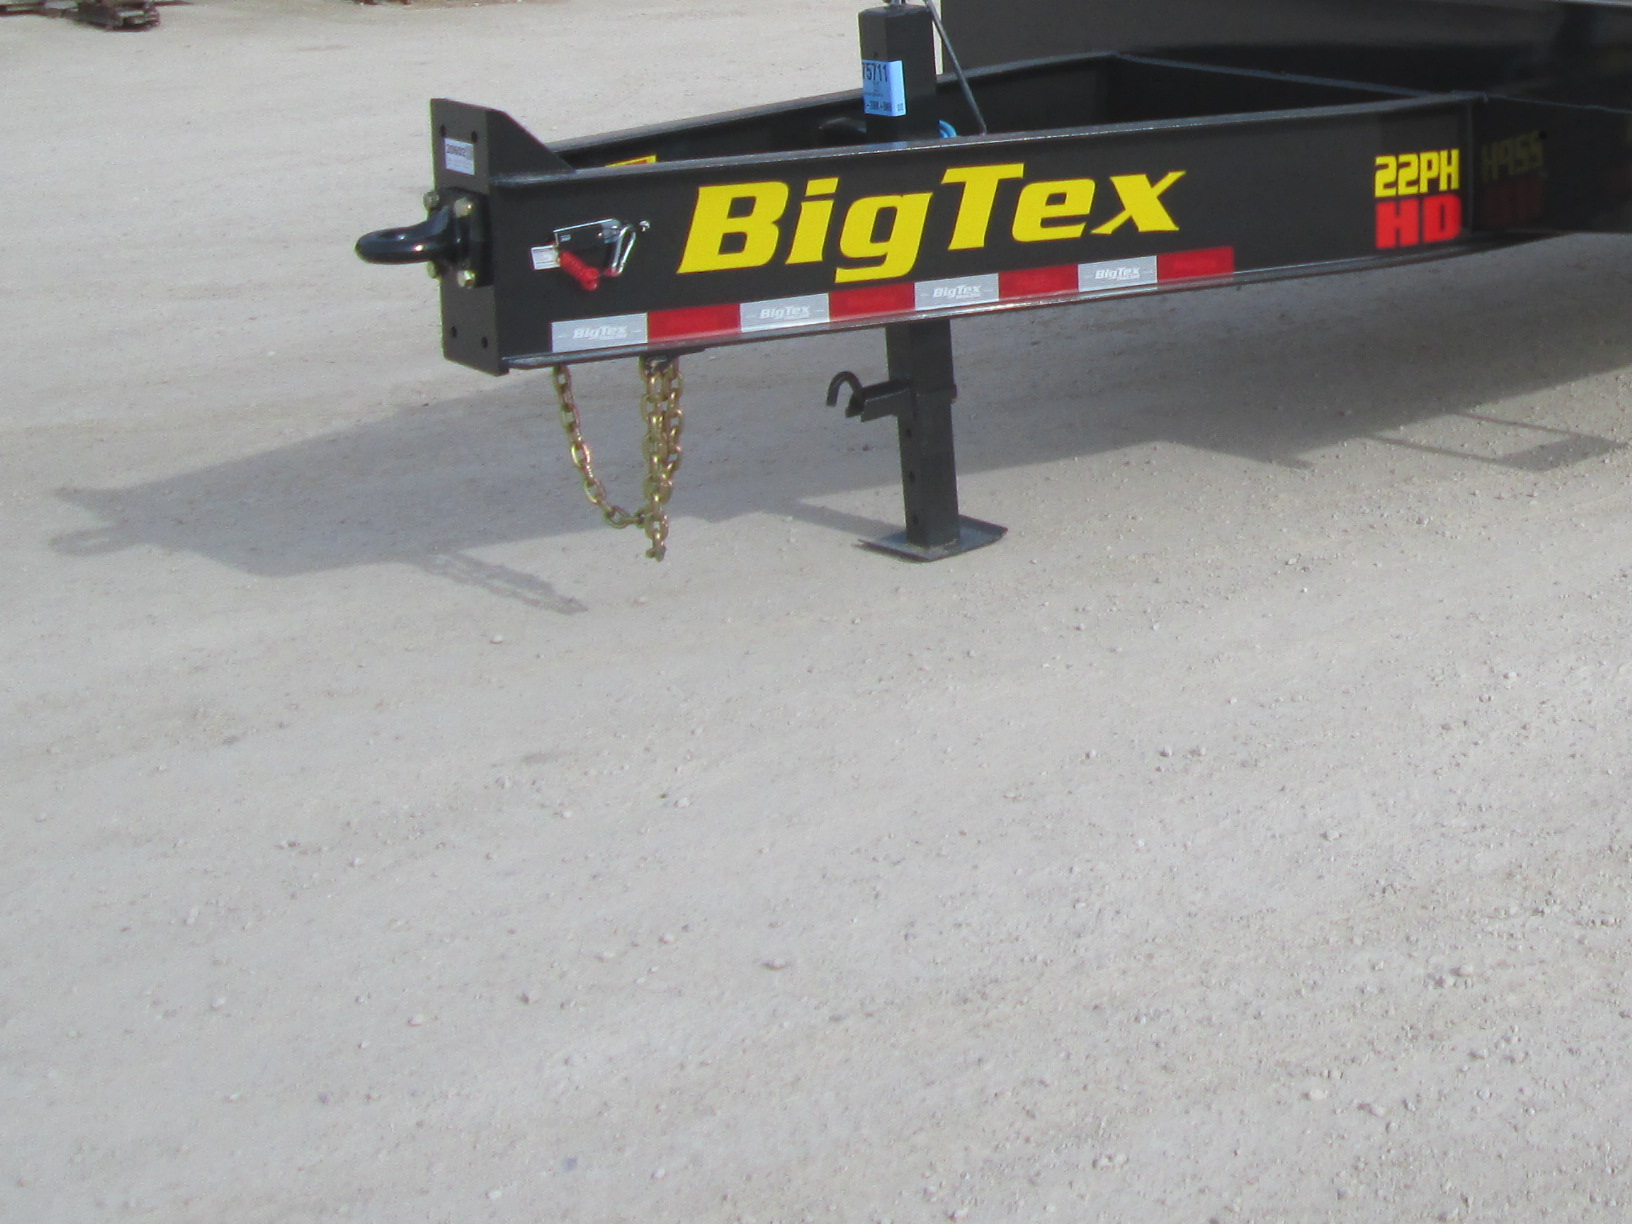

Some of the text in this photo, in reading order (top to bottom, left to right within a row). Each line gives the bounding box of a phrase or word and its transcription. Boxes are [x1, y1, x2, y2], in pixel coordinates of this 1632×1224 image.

[1375, 148, 1460, 199] 22PH
[677, 162, 1187, 284] BigTex
[1375, 193, 1462, 250] HD
